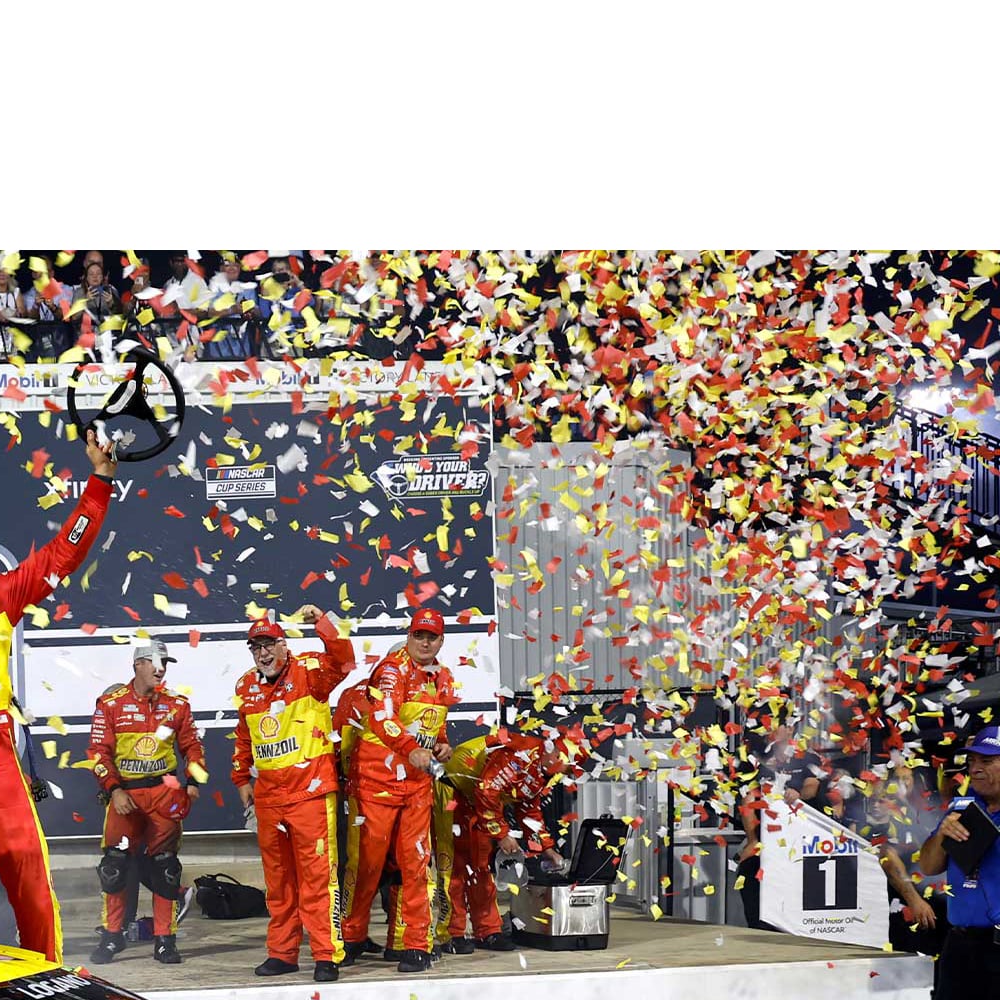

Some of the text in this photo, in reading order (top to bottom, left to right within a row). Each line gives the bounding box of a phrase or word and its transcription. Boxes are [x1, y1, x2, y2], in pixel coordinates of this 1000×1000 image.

[435, 461, 468, 473] YOUR
[228, 469, 265, 479] NASCAR
[216, 482, 266, 492] CUP SERIES
[408, 472, 487, 491] DRIVER?
[120, 758, 168, 772] PENNZOIL
[802, 917, 824, 925] Official
[817, 926, 845, 934] NASCAR
[16, 974, 92, 1000] LOGANO
